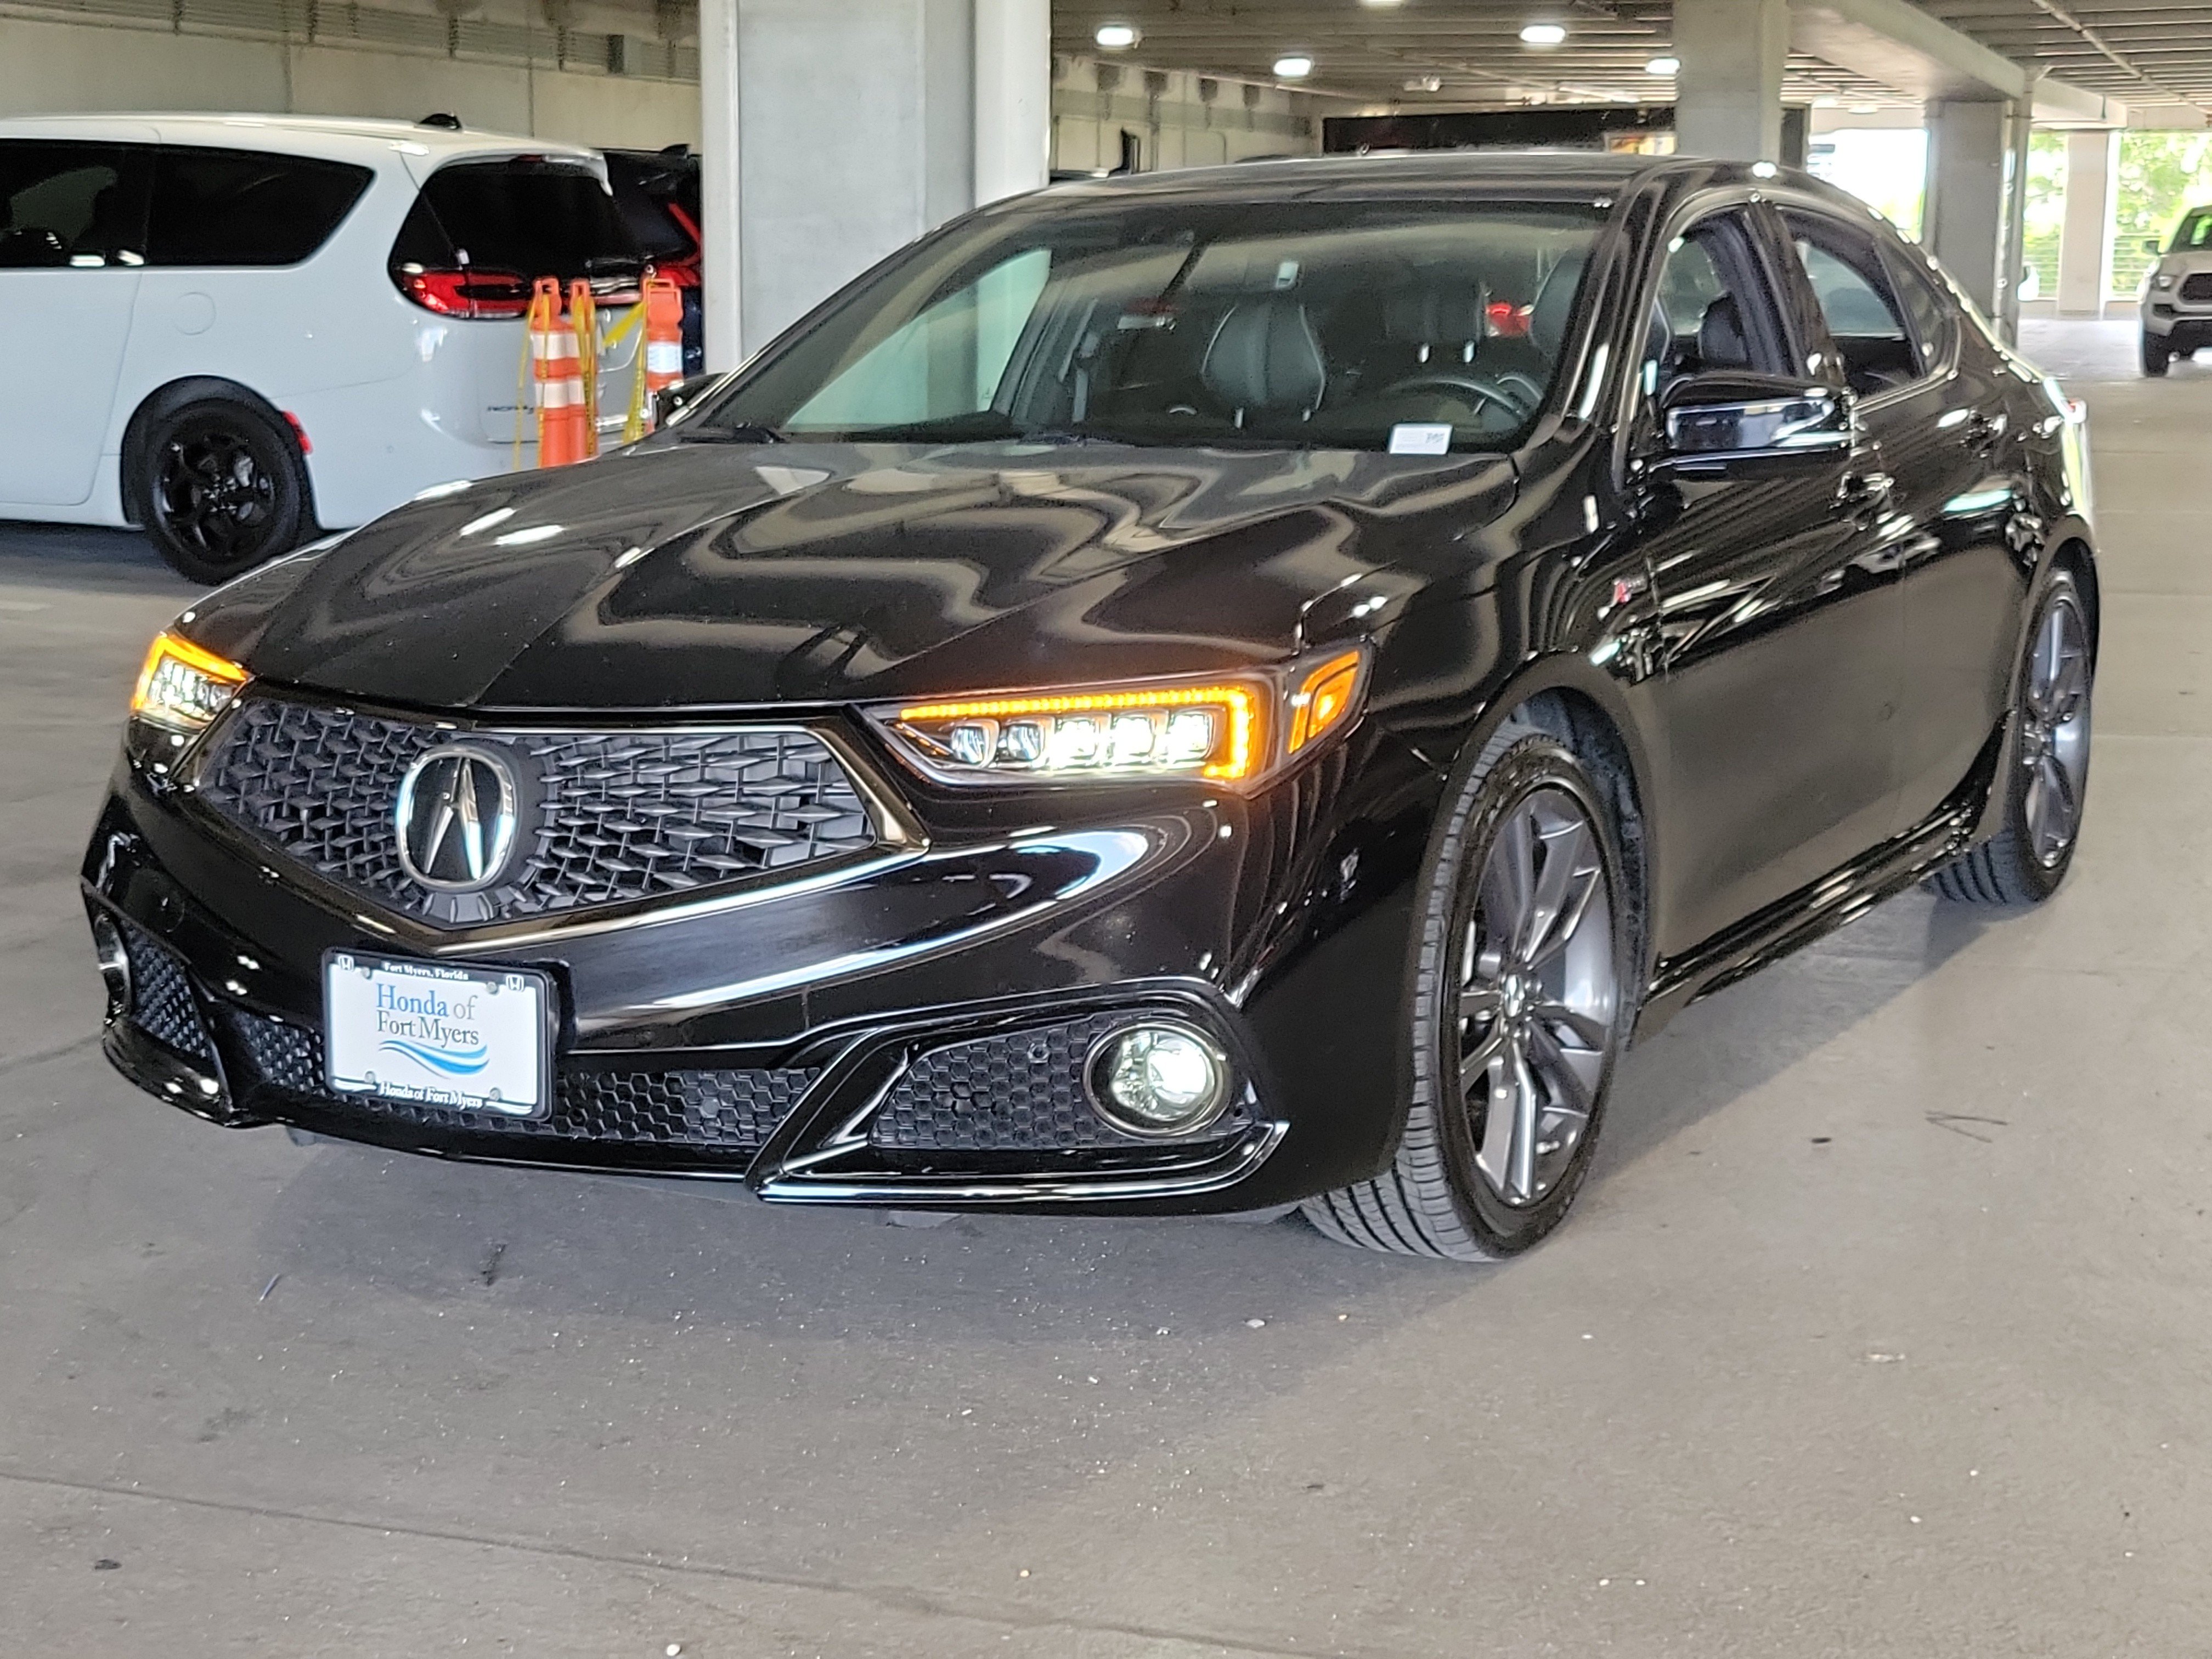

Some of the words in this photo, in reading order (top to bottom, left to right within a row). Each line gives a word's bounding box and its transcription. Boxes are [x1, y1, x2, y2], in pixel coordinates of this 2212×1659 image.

[384, 962, 403, 973] Fort
[435, 968, 469, 980] Florida
[376, 983, 449, 1017] Honda
[453, 995, 478, 1020] of
[376, 1009, 416, 1037] Fort
[417, 1016, 479, 1048] Myers
[379, 1082, 413, 1099] Honda
[425, 1086, 449, 1104] Fort
[448, 1090, 483, 1111] Myers
